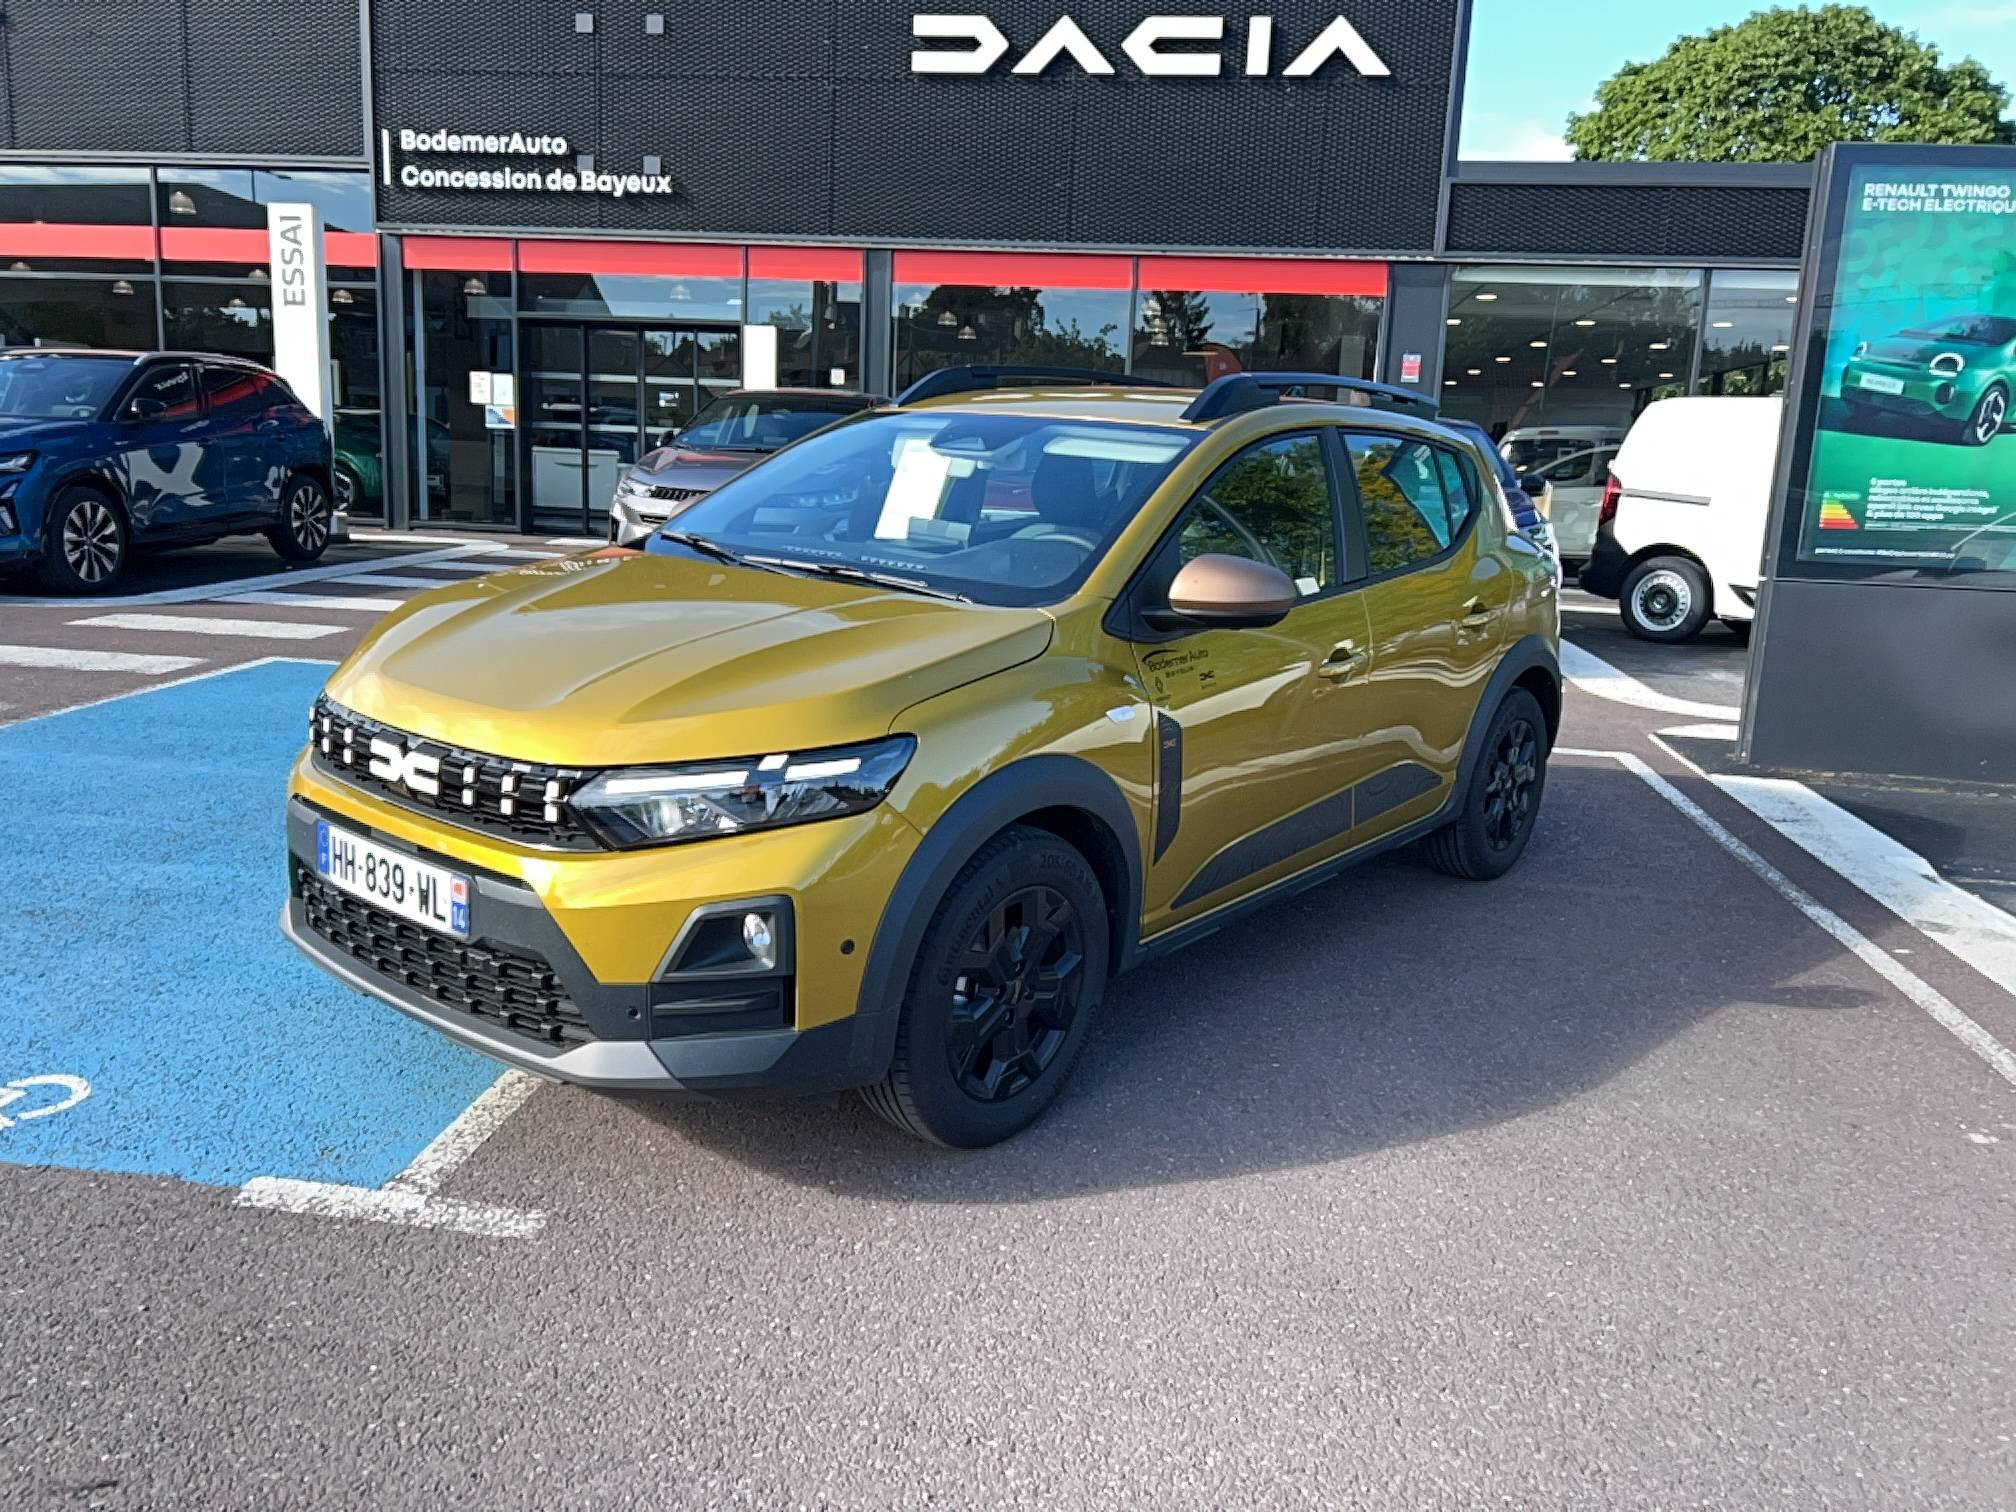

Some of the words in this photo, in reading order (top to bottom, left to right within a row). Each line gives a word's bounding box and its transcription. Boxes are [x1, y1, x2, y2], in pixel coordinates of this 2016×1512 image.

[910, 14, 1392, 77] DACIA
[400, 128, 568, 155] BodemerAuto
[400, 165, 542, 190] Concession
[546, 169, 577, 191] de
[580, 170, 672, 197] Bayeux
[1864, 183, 1938, 197] RENAULT
[1940, 184, 2012, 198] TWINGO
[1862, 198, 1922, 212] E-TECH
[280, 215, 306, 306] ESSAI
